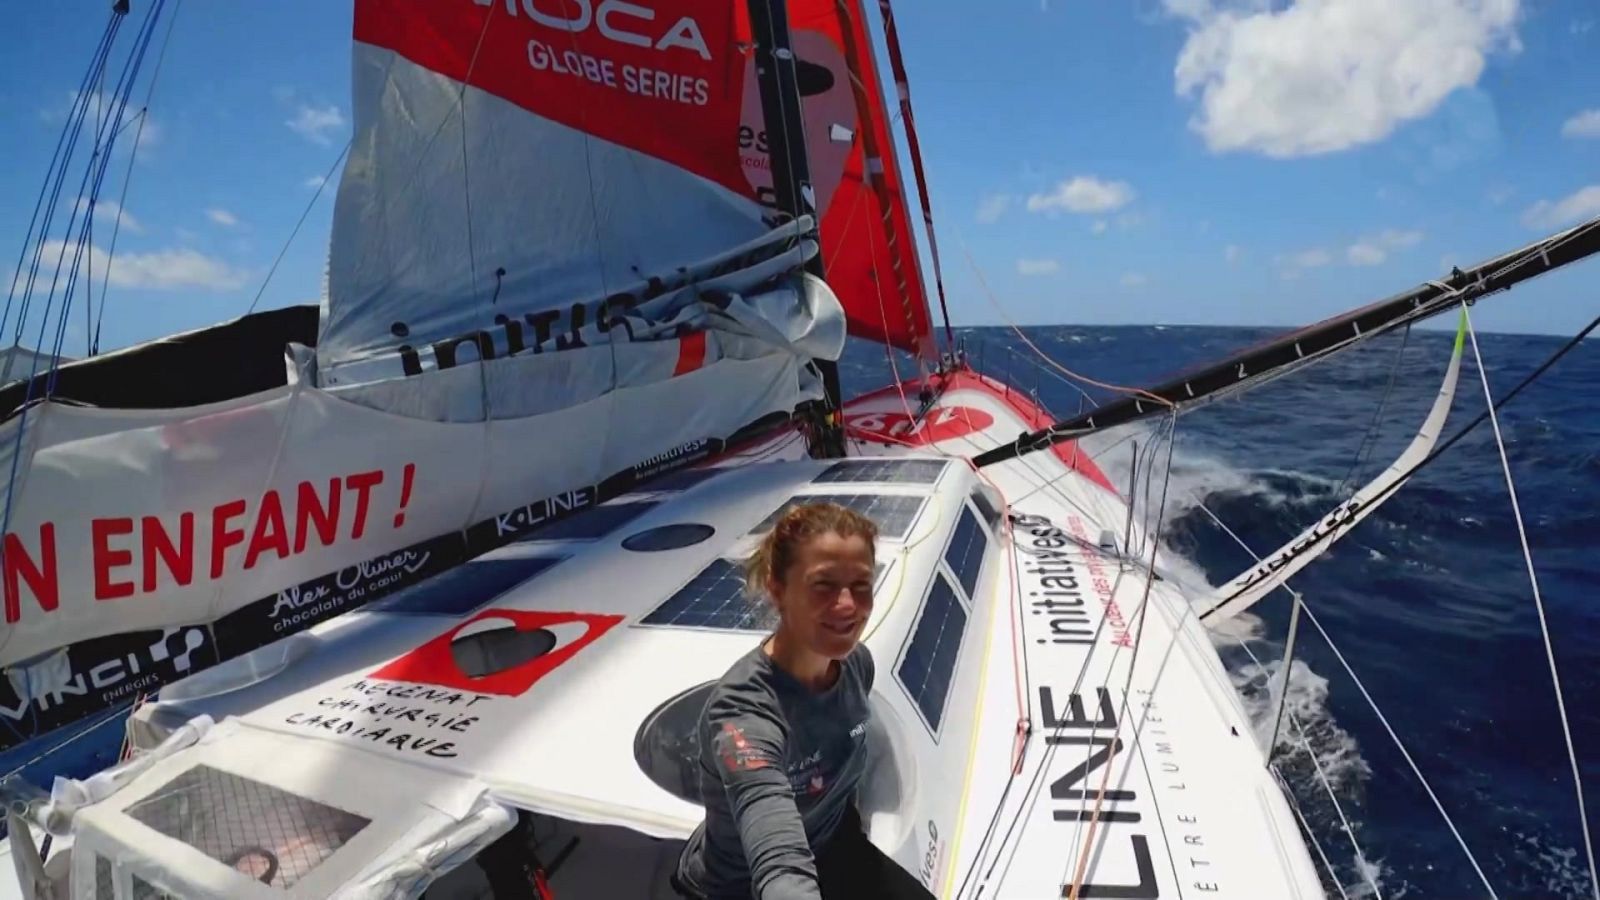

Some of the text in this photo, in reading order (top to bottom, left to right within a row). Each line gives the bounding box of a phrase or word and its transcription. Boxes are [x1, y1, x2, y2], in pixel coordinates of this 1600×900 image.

[527, 39, 710, 106] GLOBE SERIES
[3, 462, 416, 624] N ENFANT !
[267, 584, 331, 618] Alex
[273, 594, 345, 632] chocolats
[349, 586, 366, 601] du
[1024, 526, 1097, 645] initiatives
[102, 671, 161, 703] ENERGIES
